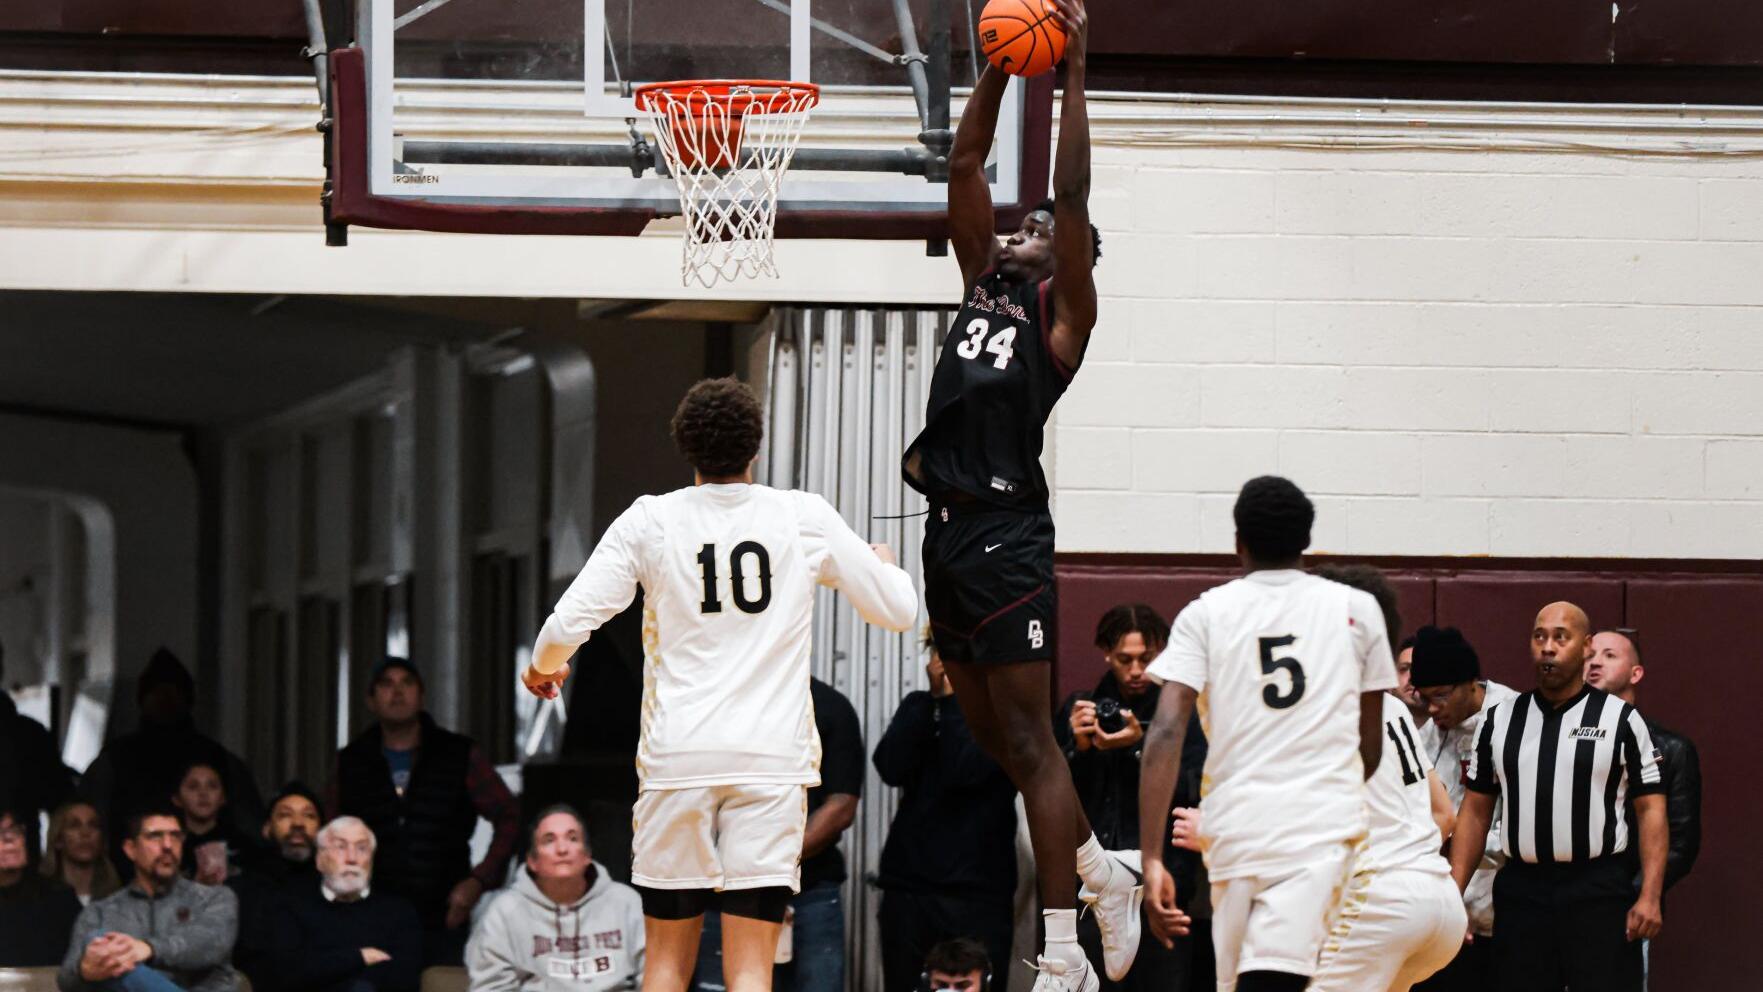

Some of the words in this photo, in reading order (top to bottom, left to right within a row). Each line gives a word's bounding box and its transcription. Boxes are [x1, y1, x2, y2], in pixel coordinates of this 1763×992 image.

[393, 175, 439, 184] IRONMEN
[968, 286, 995, 312] The
[957, 318, 1017, 370] 34
[696, 540, 773, 614] 10
[1258, 633, 1306, 710] 5
[1386, 716, 1425, 786] 11
